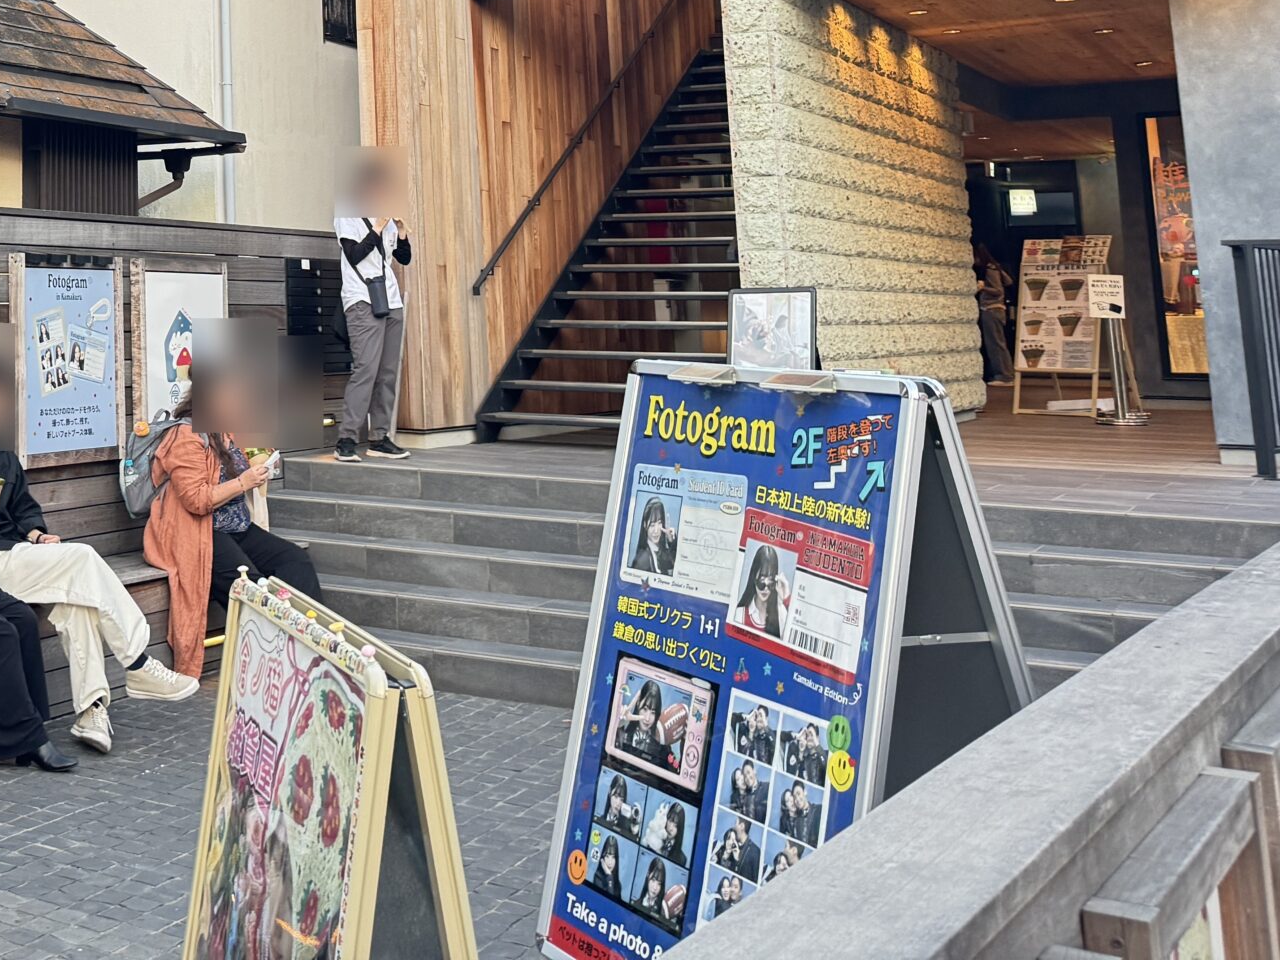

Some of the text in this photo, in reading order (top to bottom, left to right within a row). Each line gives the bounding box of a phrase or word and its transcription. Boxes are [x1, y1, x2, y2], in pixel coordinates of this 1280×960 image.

[48, 273, 87, 291] Fotogram
[644, 395, 776, 455] Fotogram
[826, 414, 893, 444] 階段を登って
[791, 427, 824, 468] 2F
[638, 471, 679, 491] Fotogram
[755, 486, 872, 530] 日本初上陸の新体験!
[749, 515, 797, 543] Fotogram
[617, 596, 694, 631] 韓国式プリクラ
[700, 614, 720, 639] 1+1
[612, 621, 729, 673] 鎌倉の思い出づくりに!
[793, 671, 824, 694] Kamakura
[566, 892, 597, 927] Take
[598, 920, 608, 934] a
[608, 923, 651, 957] photo
